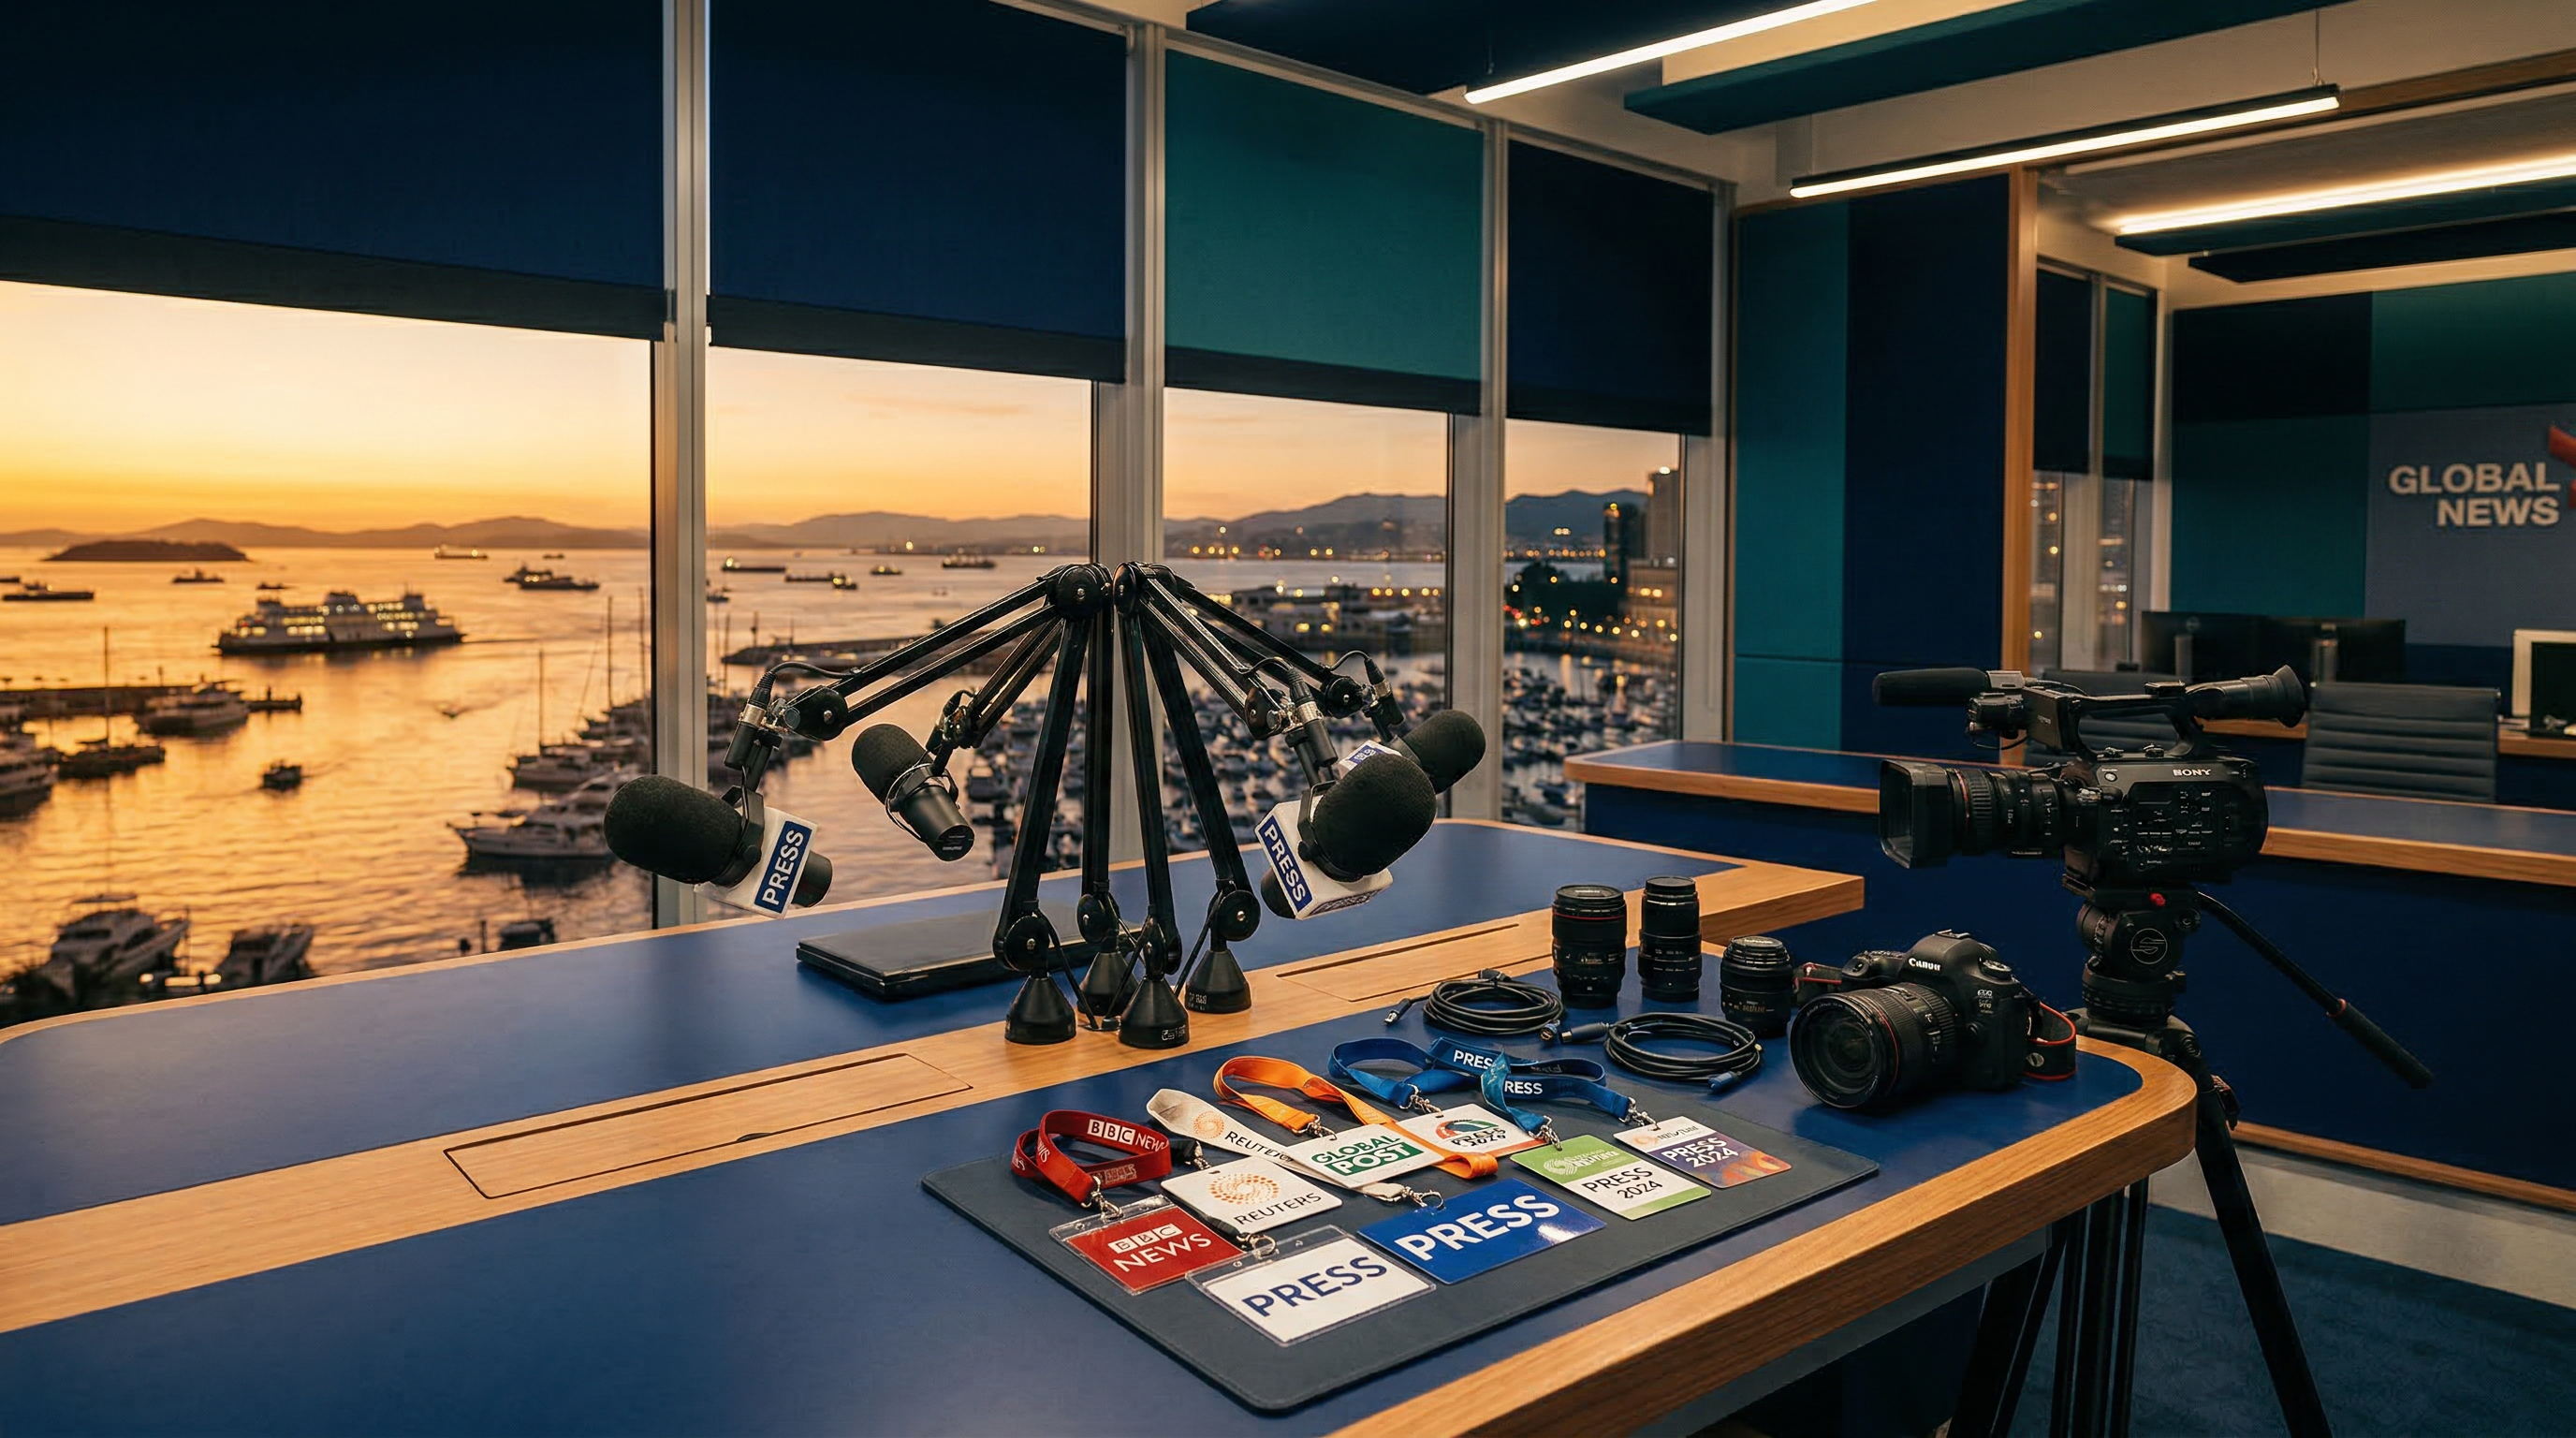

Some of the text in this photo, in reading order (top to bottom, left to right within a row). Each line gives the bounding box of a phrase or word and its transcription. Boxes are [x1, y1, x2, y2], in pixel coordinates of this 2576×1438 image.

[2388, 462, 2561, 495] GLOBAL
[2437, 496, 2560, 526] NEWS
[762, 829, 804, 905] PRESS
[1264, 824, 1307, 902] PRESS
[1453, 1049, 1494, 1069] PRES
[1504, 1080, 1543, 1094] RESS
[1088, 1120, 1134, 1144] BBC
[1224, 1131, 1294, 1163] REUTE
[1311, 1136, 1400, 1163] GLOBAL
[1331, 1143, 1411, 1173] POST
[1661, 1137, 1727, 1161] PRESS
[1686, 1147, 1738, 1167] 2024
[1582, 1167, 1653, 1193] PRESS
[1617, 1181, 1662, 1198] 2024
[1234, 1193, 1322, 1225] REUTERS
[1394, 1196, 1560, 1261] PRESS
[1113, 1233, 1211, 1272] NEWS
[1242, 1256, 1387, 1317] PRESS
